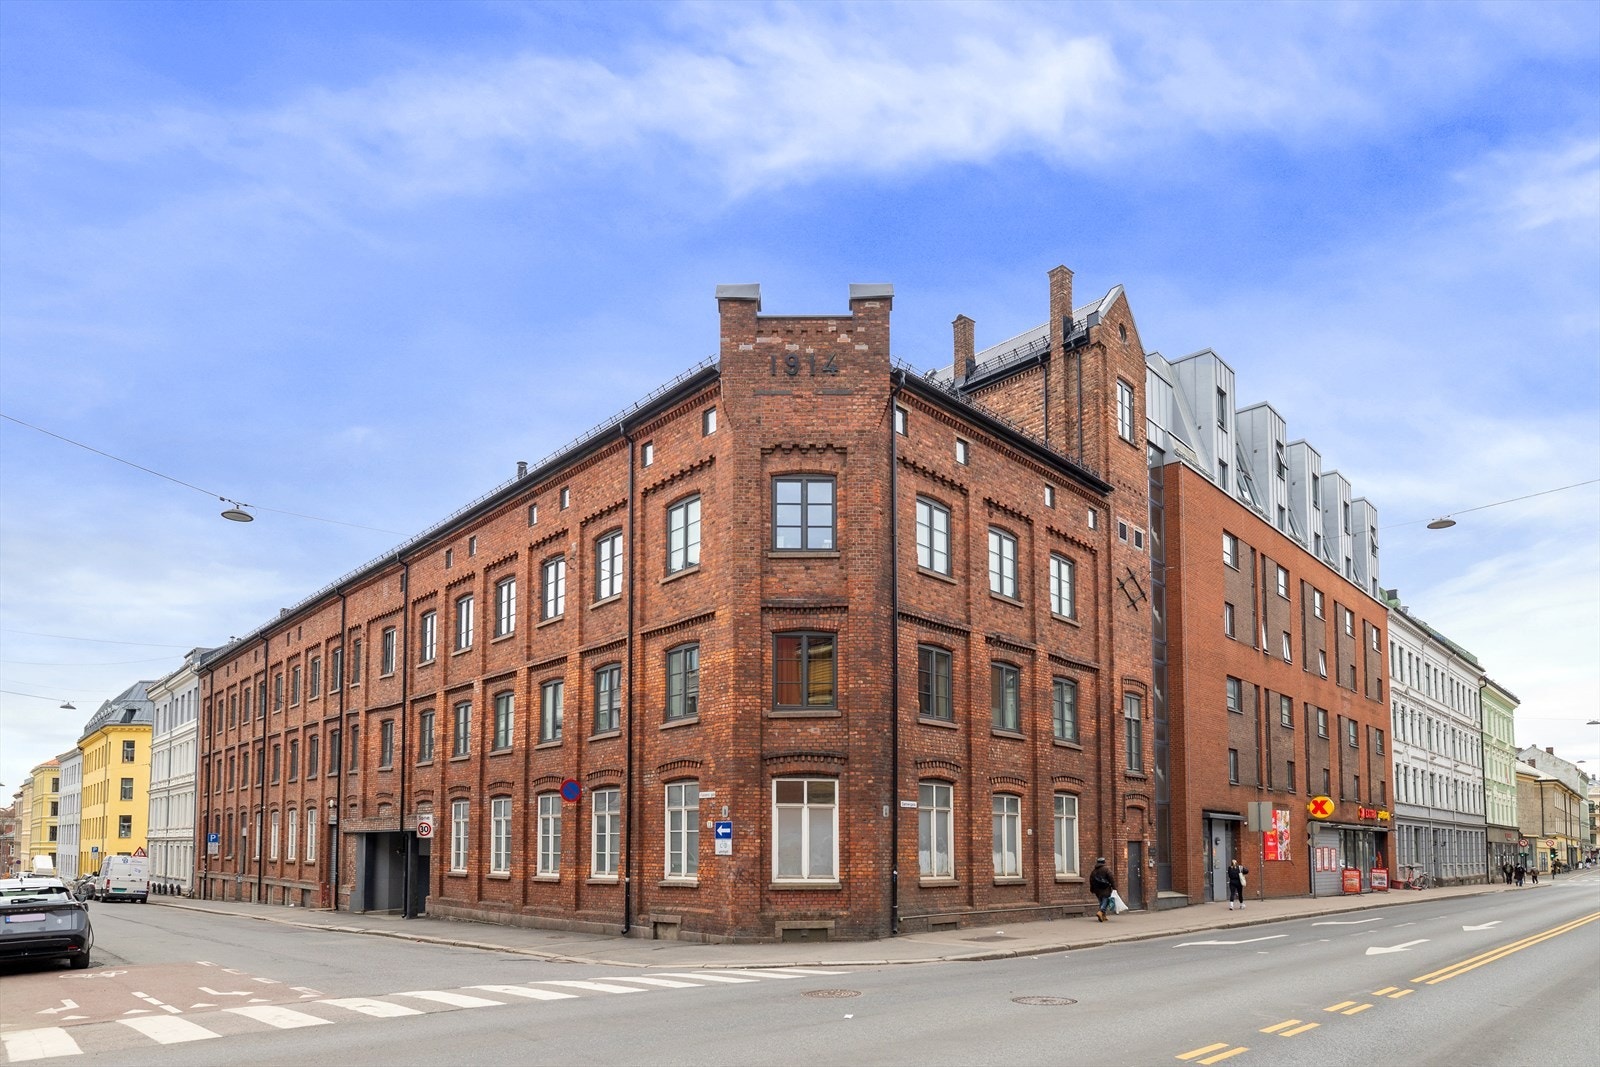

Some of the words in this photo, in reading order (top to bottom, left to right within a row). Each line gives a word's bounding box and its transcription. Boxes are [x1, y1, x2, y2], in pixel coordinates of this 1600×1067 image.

[770, 353, 839, 377] 1914
[420, 825, 428, 833] 30
[210, 834, 217, 842] P
